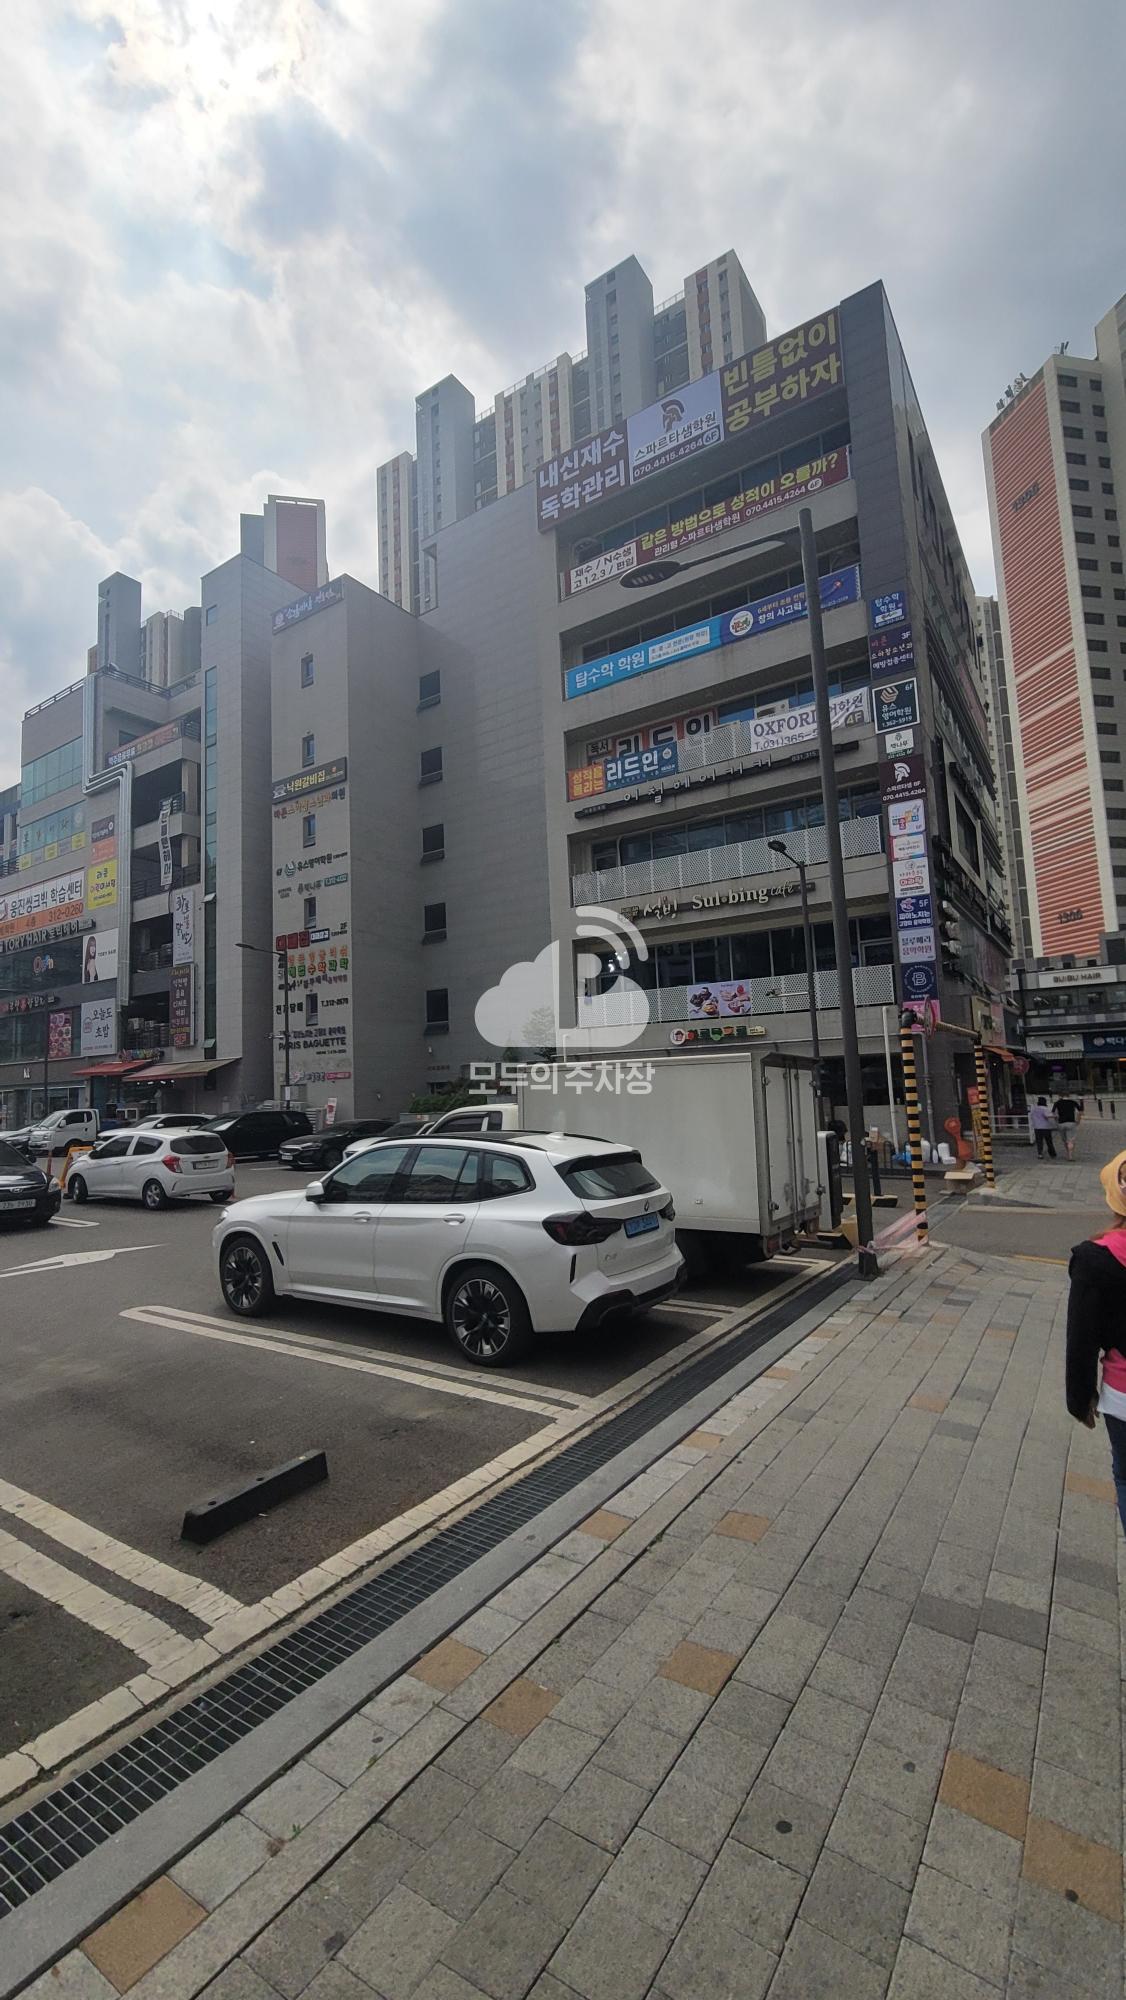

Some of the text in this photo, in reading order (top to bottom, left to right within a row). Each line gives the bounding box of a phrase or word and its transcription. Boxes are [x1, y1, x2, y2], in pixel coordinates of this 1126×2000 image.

[723, 313, 836, 397] 빈틈없이
[726, 352, 841, 432] 공부하자
[539, 430, 625, 488] 내신재수
[540, 459, 626, 519] 독학관리
[640, 453, 838, 550] 같은 방법으로 성적이 오를까?
[575, 650, 645, 689] 탑수학 학원
[606, 750, 659, 781] 리드인
[50, 880, 82, 906] 학습센터
[92, 1008, 113, 1021] 오늘도
[303, 1036, 347, 1049] BAGUETTE
